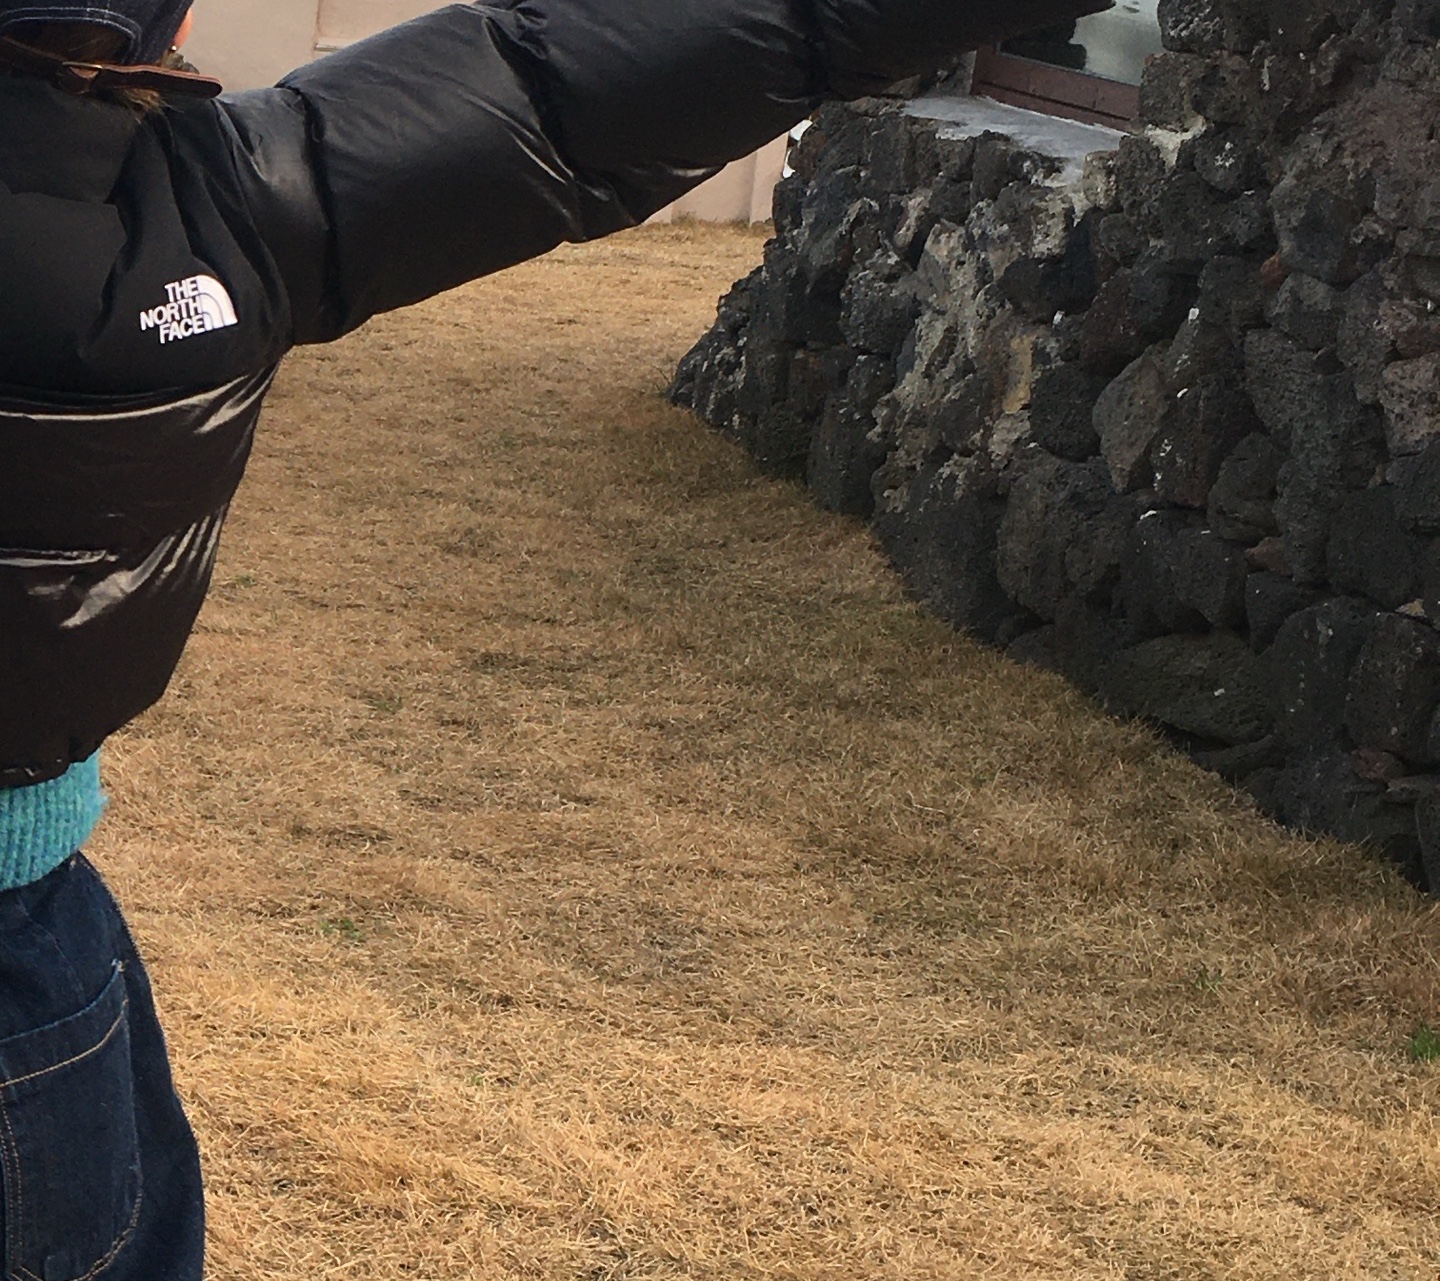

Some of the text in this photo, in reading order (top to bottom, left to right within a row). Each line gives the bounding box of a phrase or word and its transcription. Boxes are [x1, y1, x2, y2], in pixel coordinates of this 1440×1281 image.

[164, 277, 199, 302] THE
[140, 295, 202, 331] NORTH
[160, 314, 205, 344] FACE
